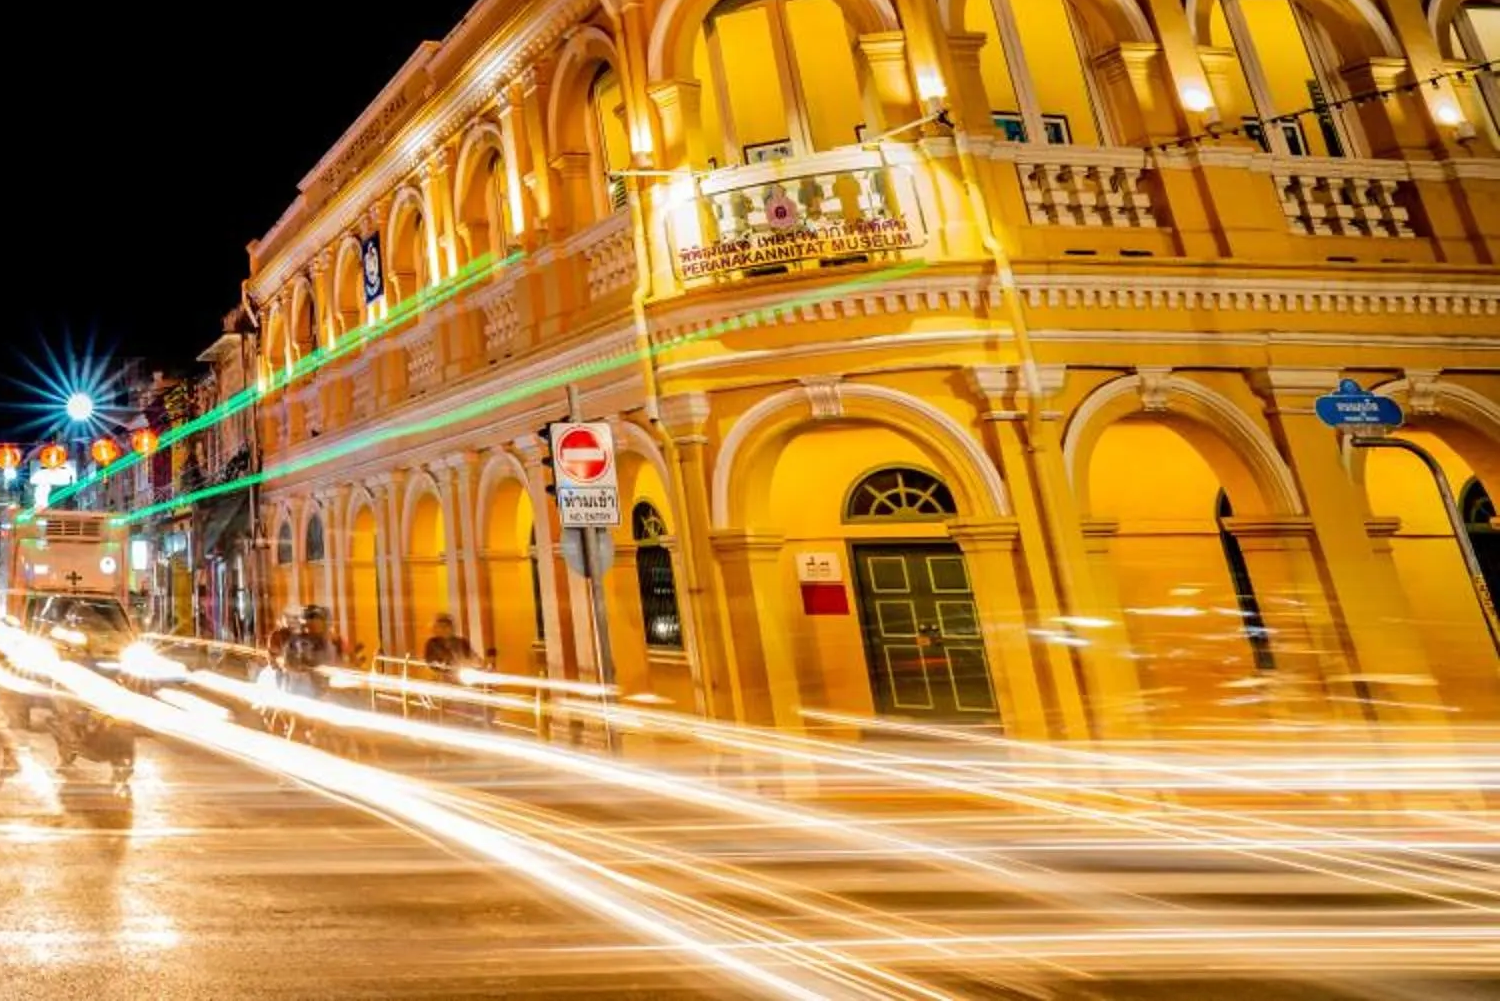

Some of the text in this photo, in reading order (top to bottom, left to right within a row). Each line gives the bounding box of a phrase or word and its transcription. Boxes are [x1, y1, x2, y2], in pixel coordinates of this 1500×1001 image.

[682, 231, 913, 276] PERANAKANNITAT MUSEUM
[563, 490, 615, 508] ห้ามเข้า
